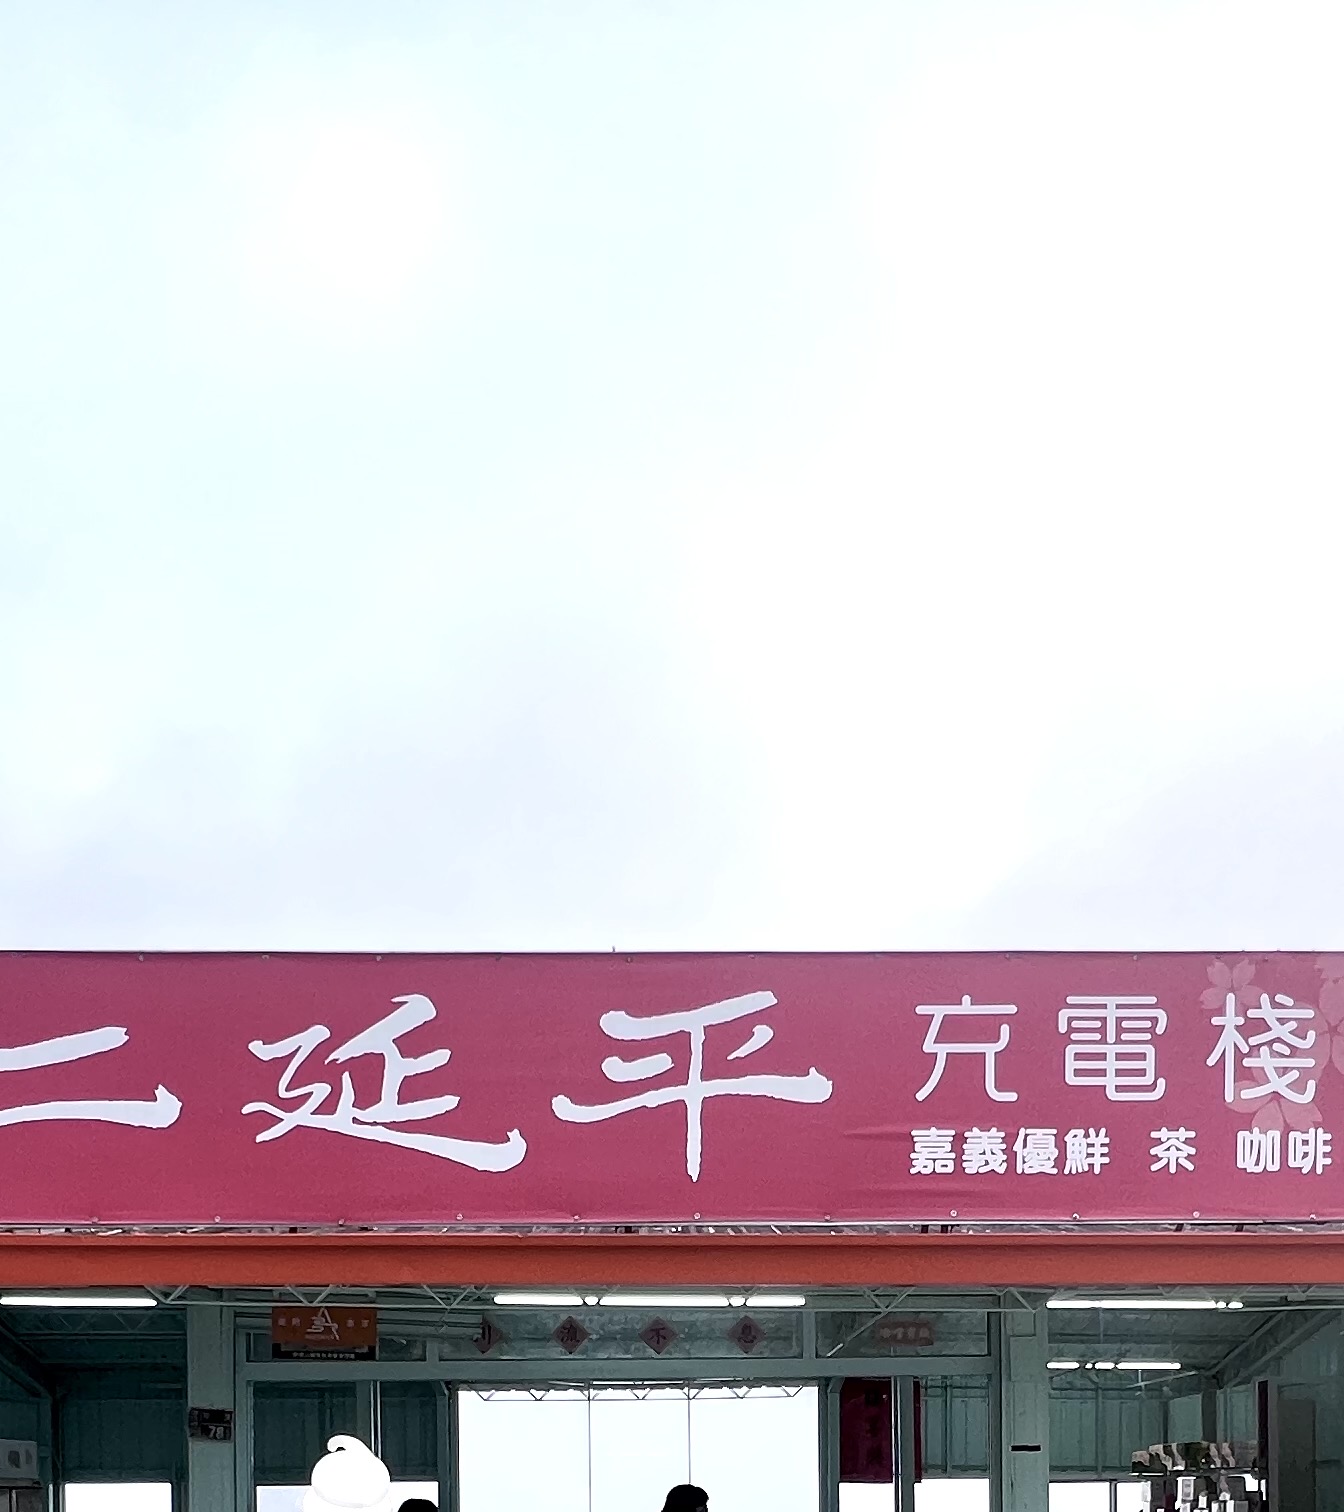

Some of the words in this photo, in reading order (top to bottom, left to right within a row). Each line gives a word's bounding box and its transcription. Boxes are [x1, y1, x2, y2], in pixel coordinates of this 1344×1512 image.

[914, 992, 1317, 1104] 充電棧
[908, 1126, 1111, 1176] 嘉義優鮮
[1149, 1126, 1198, 1175] 茶
[1236, 1125, 1333, 1175] 咖啡
